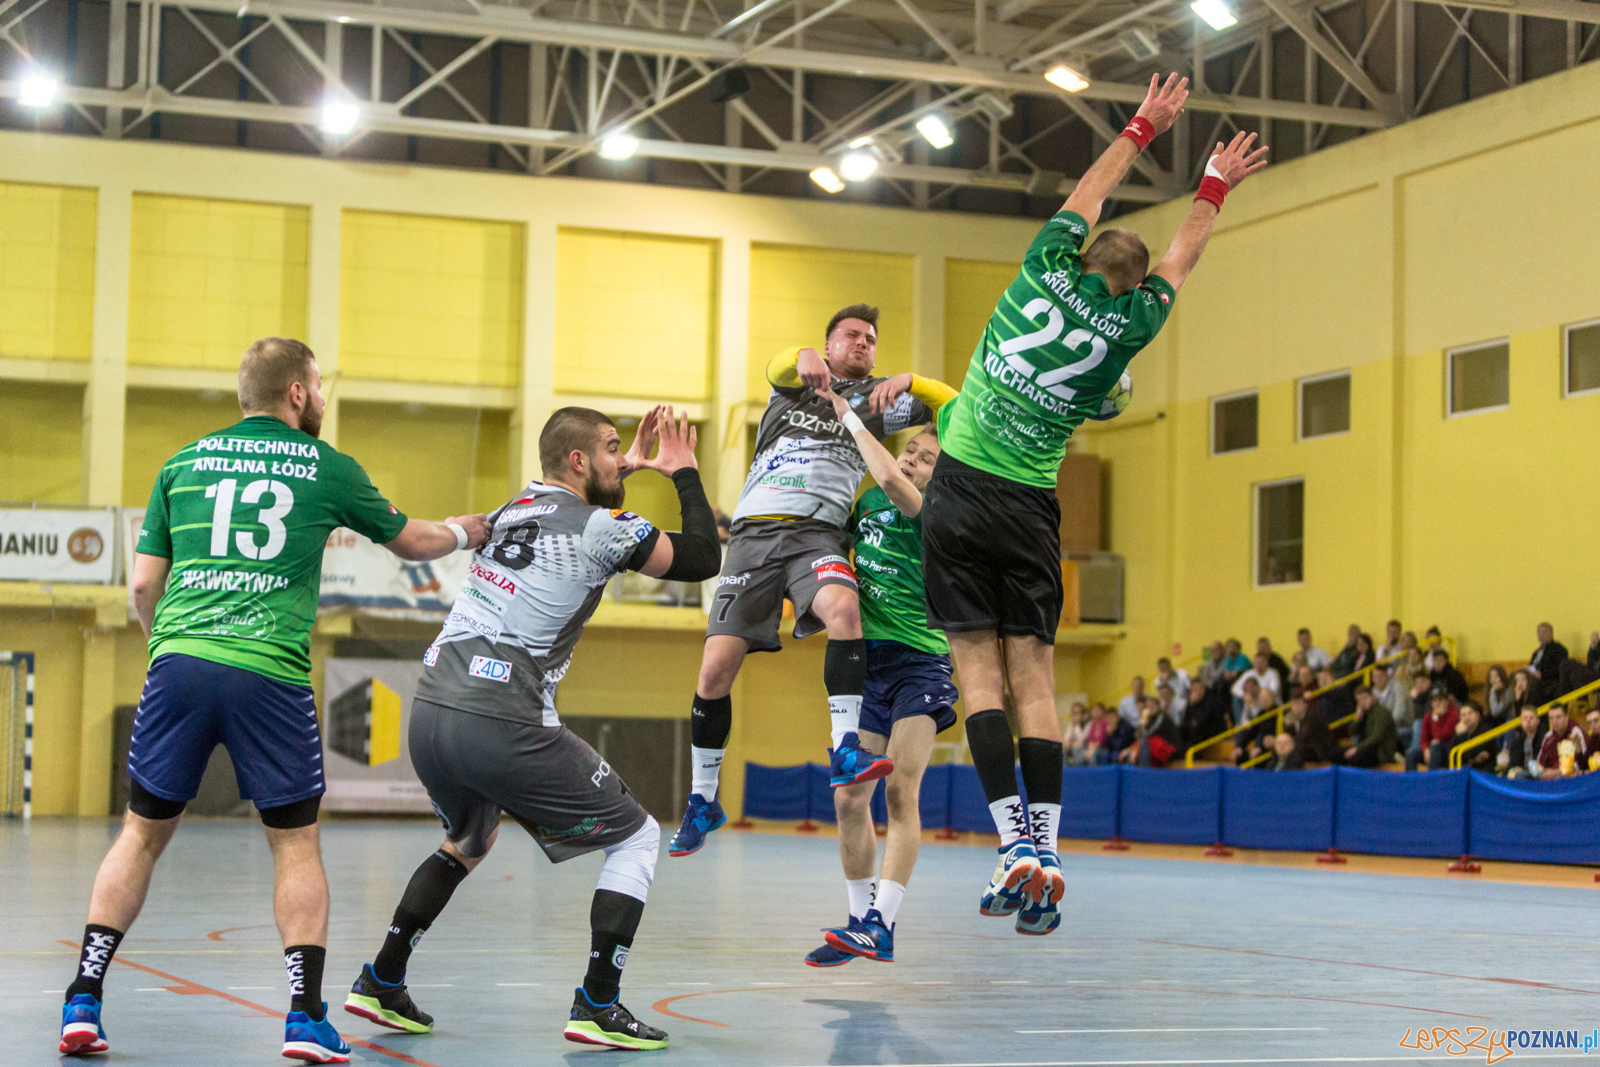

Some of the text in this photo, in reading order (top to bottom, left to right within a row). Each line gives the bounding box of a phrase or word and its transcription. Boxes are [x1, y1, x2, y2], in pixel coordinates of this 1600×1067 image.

[1000, 297, 1108, 401] 22
[196, 437, 320, 460] POLITECHNIKA
[192, 457, 318, 482] ANILANA ŁÓDŹ
[204, 478, 294, 561] 13
[0, 532, 59, 555] ANIU
[493, 519, 540, 571] 8
[717, 592, 738, 622] 7
[479, 660, 506, 679] 4D
